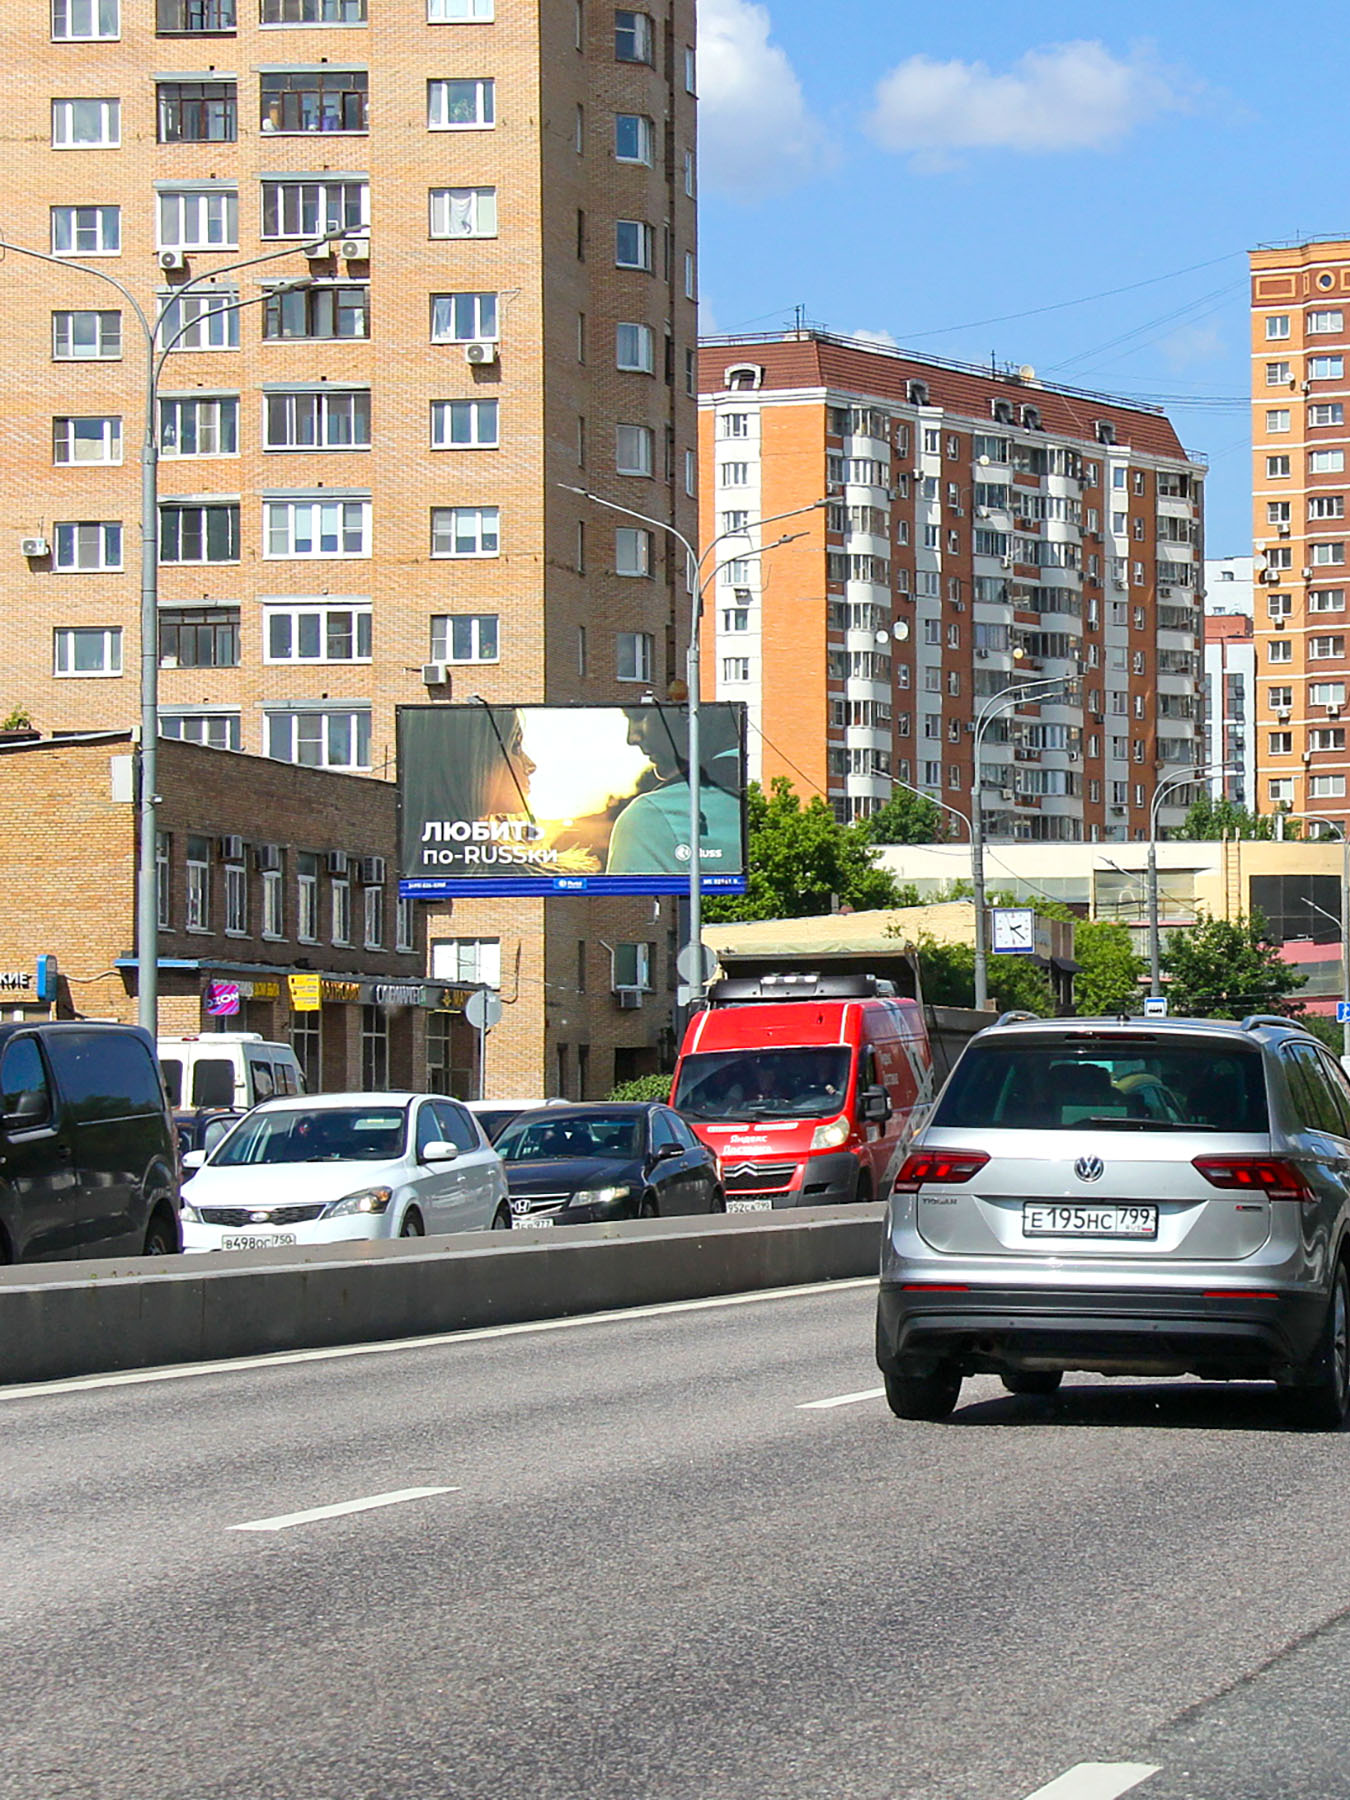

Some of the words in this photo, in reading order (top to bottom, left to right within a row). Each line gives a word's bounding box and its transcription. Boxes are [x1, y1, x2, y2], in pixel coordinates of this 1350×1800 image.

[421, 821, 545, 842] ЛЮБИТЬ
[423, 845, 558, 865] по-RUSSки
[1118, 1207, 1150, 1225] 799
